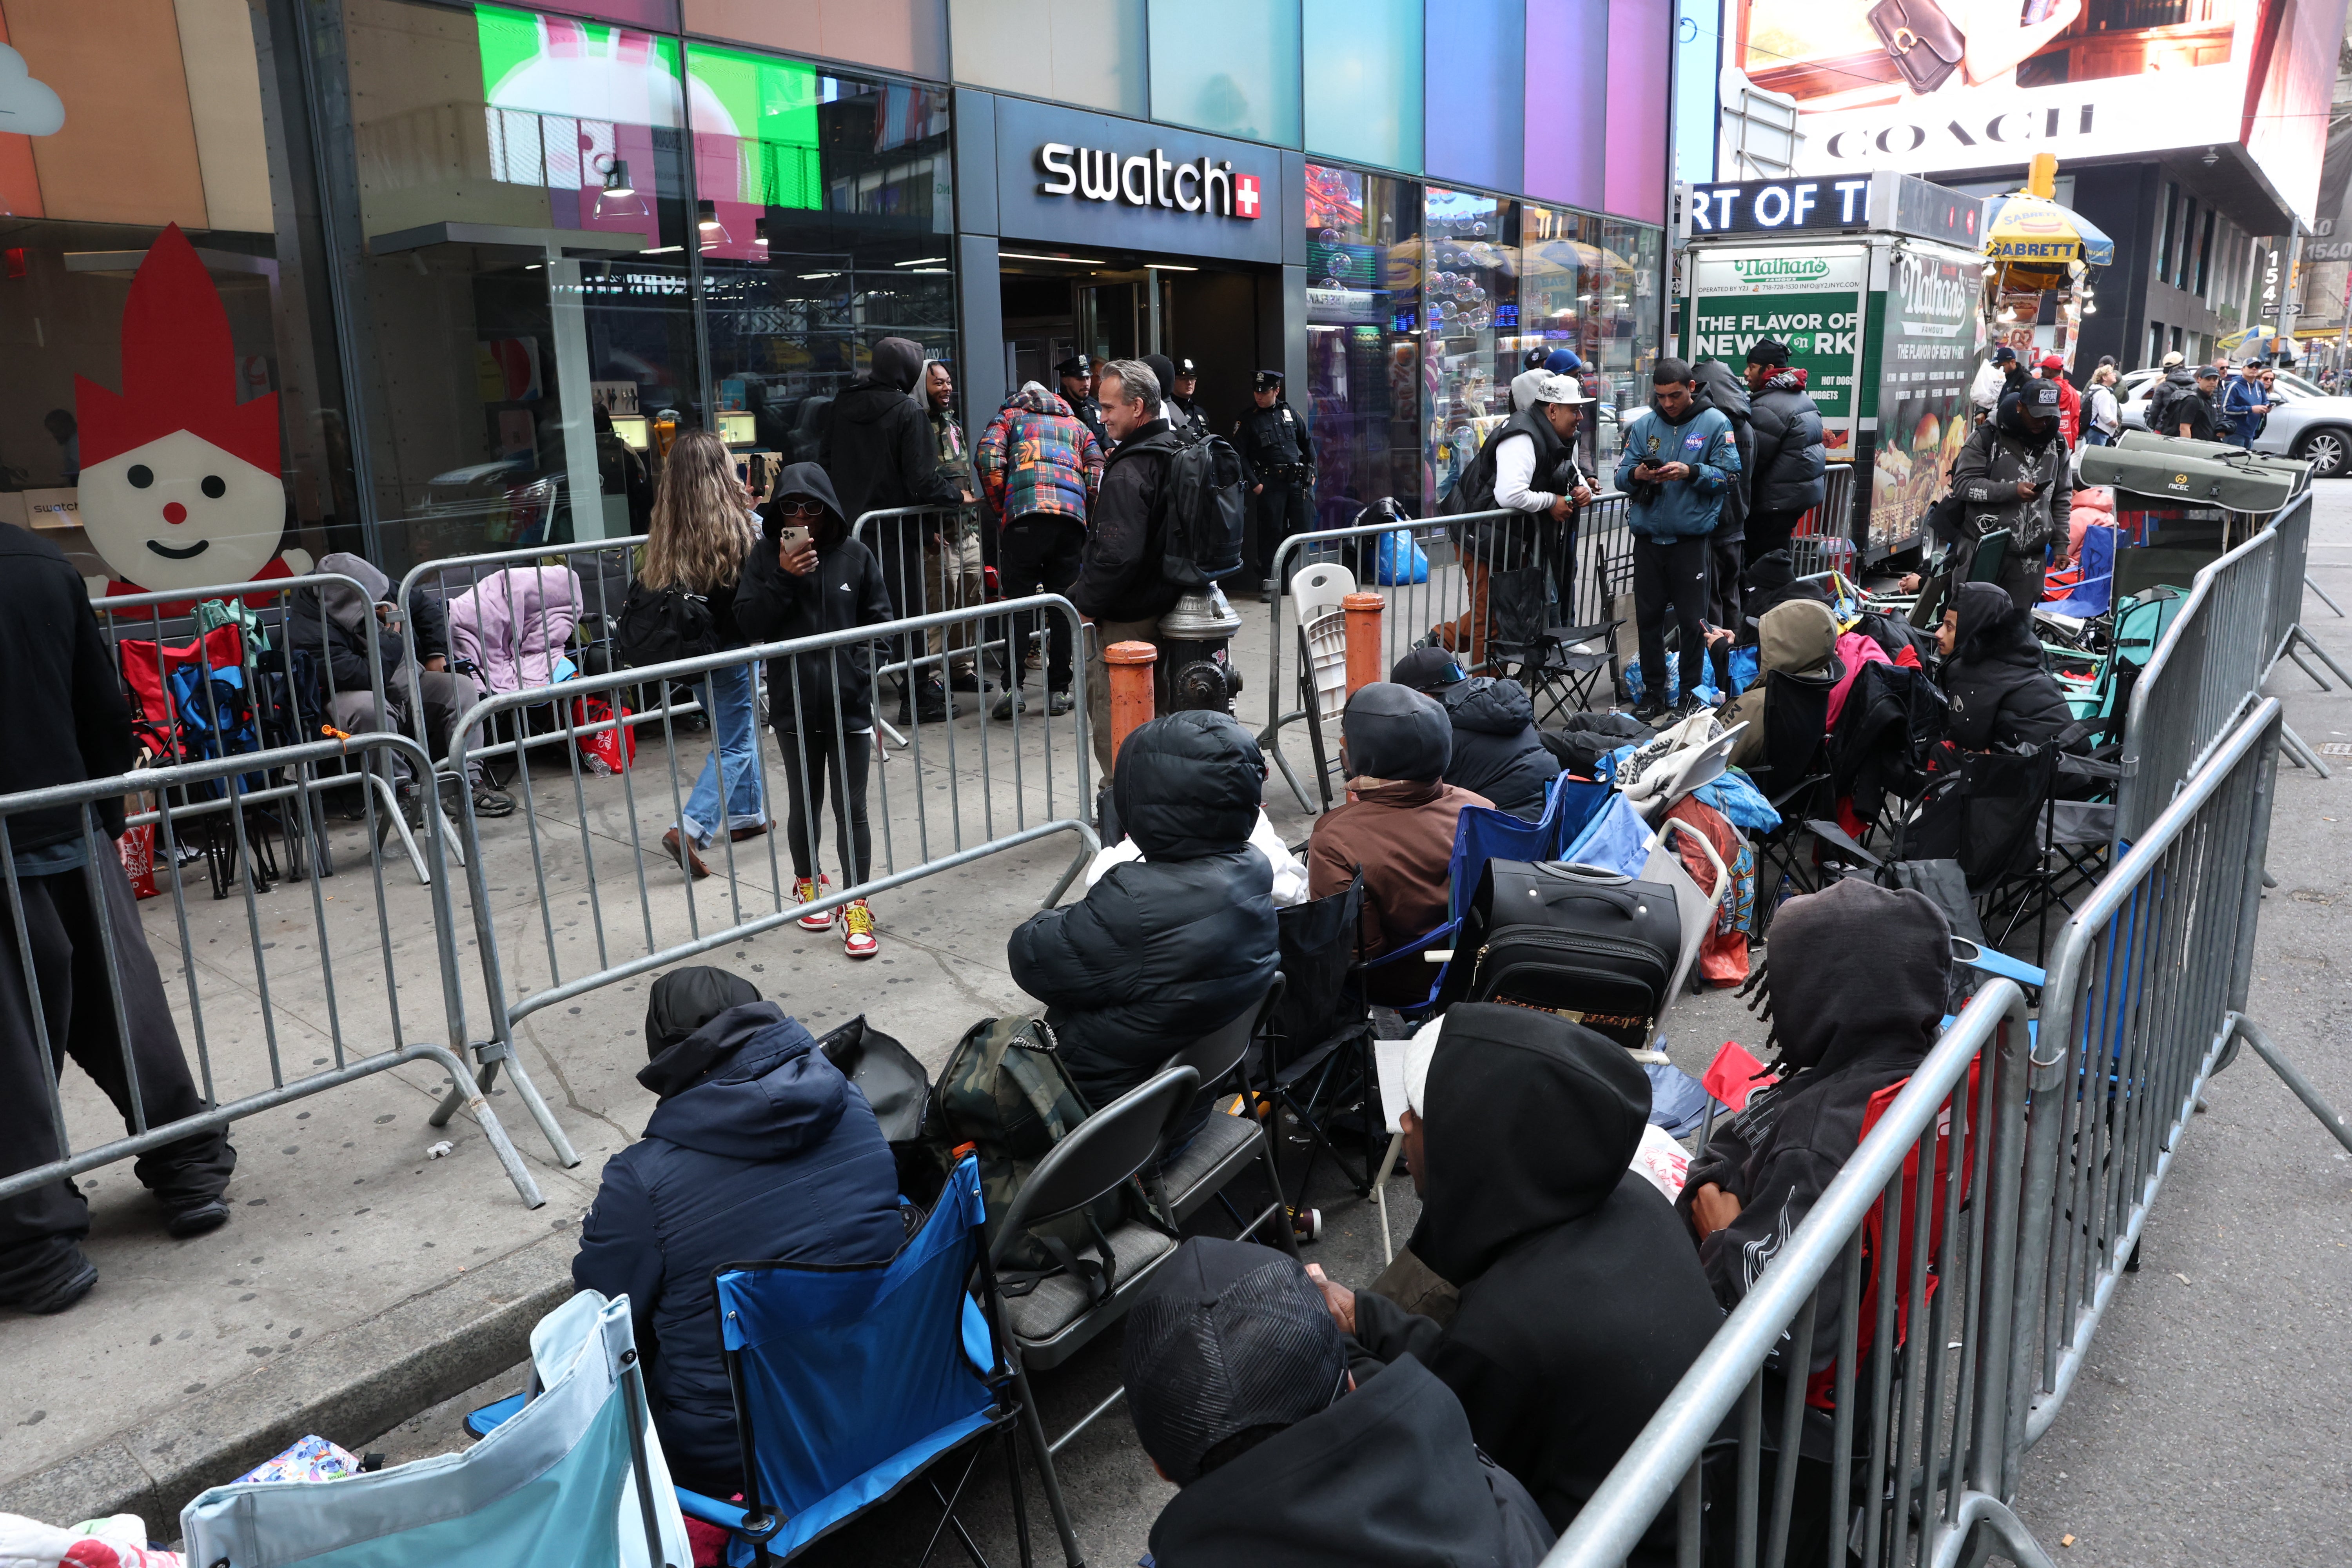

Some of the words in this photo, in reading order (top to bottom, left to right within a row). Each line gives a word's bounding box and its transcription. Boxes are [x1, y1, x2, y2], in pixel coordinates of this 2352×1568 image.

[1042, 142, 1230, 216] swatch
[1693, 189, 1740, 230] RT
[1755, 183, 1818, 227] OF
[1835, 180, 1870, 222] T
[2004, 212, 2057, 225] SABRETT
[1991, 241, 2075, 257] SABRETT
[1734, 257, 1830, 276] Nathan's
[1900, 252, 1966, 318] Nathan's
[1698, 316, 1736, 331] THE
[1741, 313, 1822, 330] FLAVOR
[1828, 313, 1857, 329] OF
[1697, 333, 1765, 356] NEW
[1897, 344, 1907, 359] THE
[1909, 344, 1931, 359] FLAVOR
[1931, 345, 1940, 359] OF
[1940, 345, 1952, 359] NEW
[1821, 376, 1835, 385] HOT
[1836, 376, 1853, 385] DOGS
[1808, 390, 1838, 400] NUGGETS
[2168, 483, 2190, 491] NICEC
[1722, 703, 1743, 729] MI
